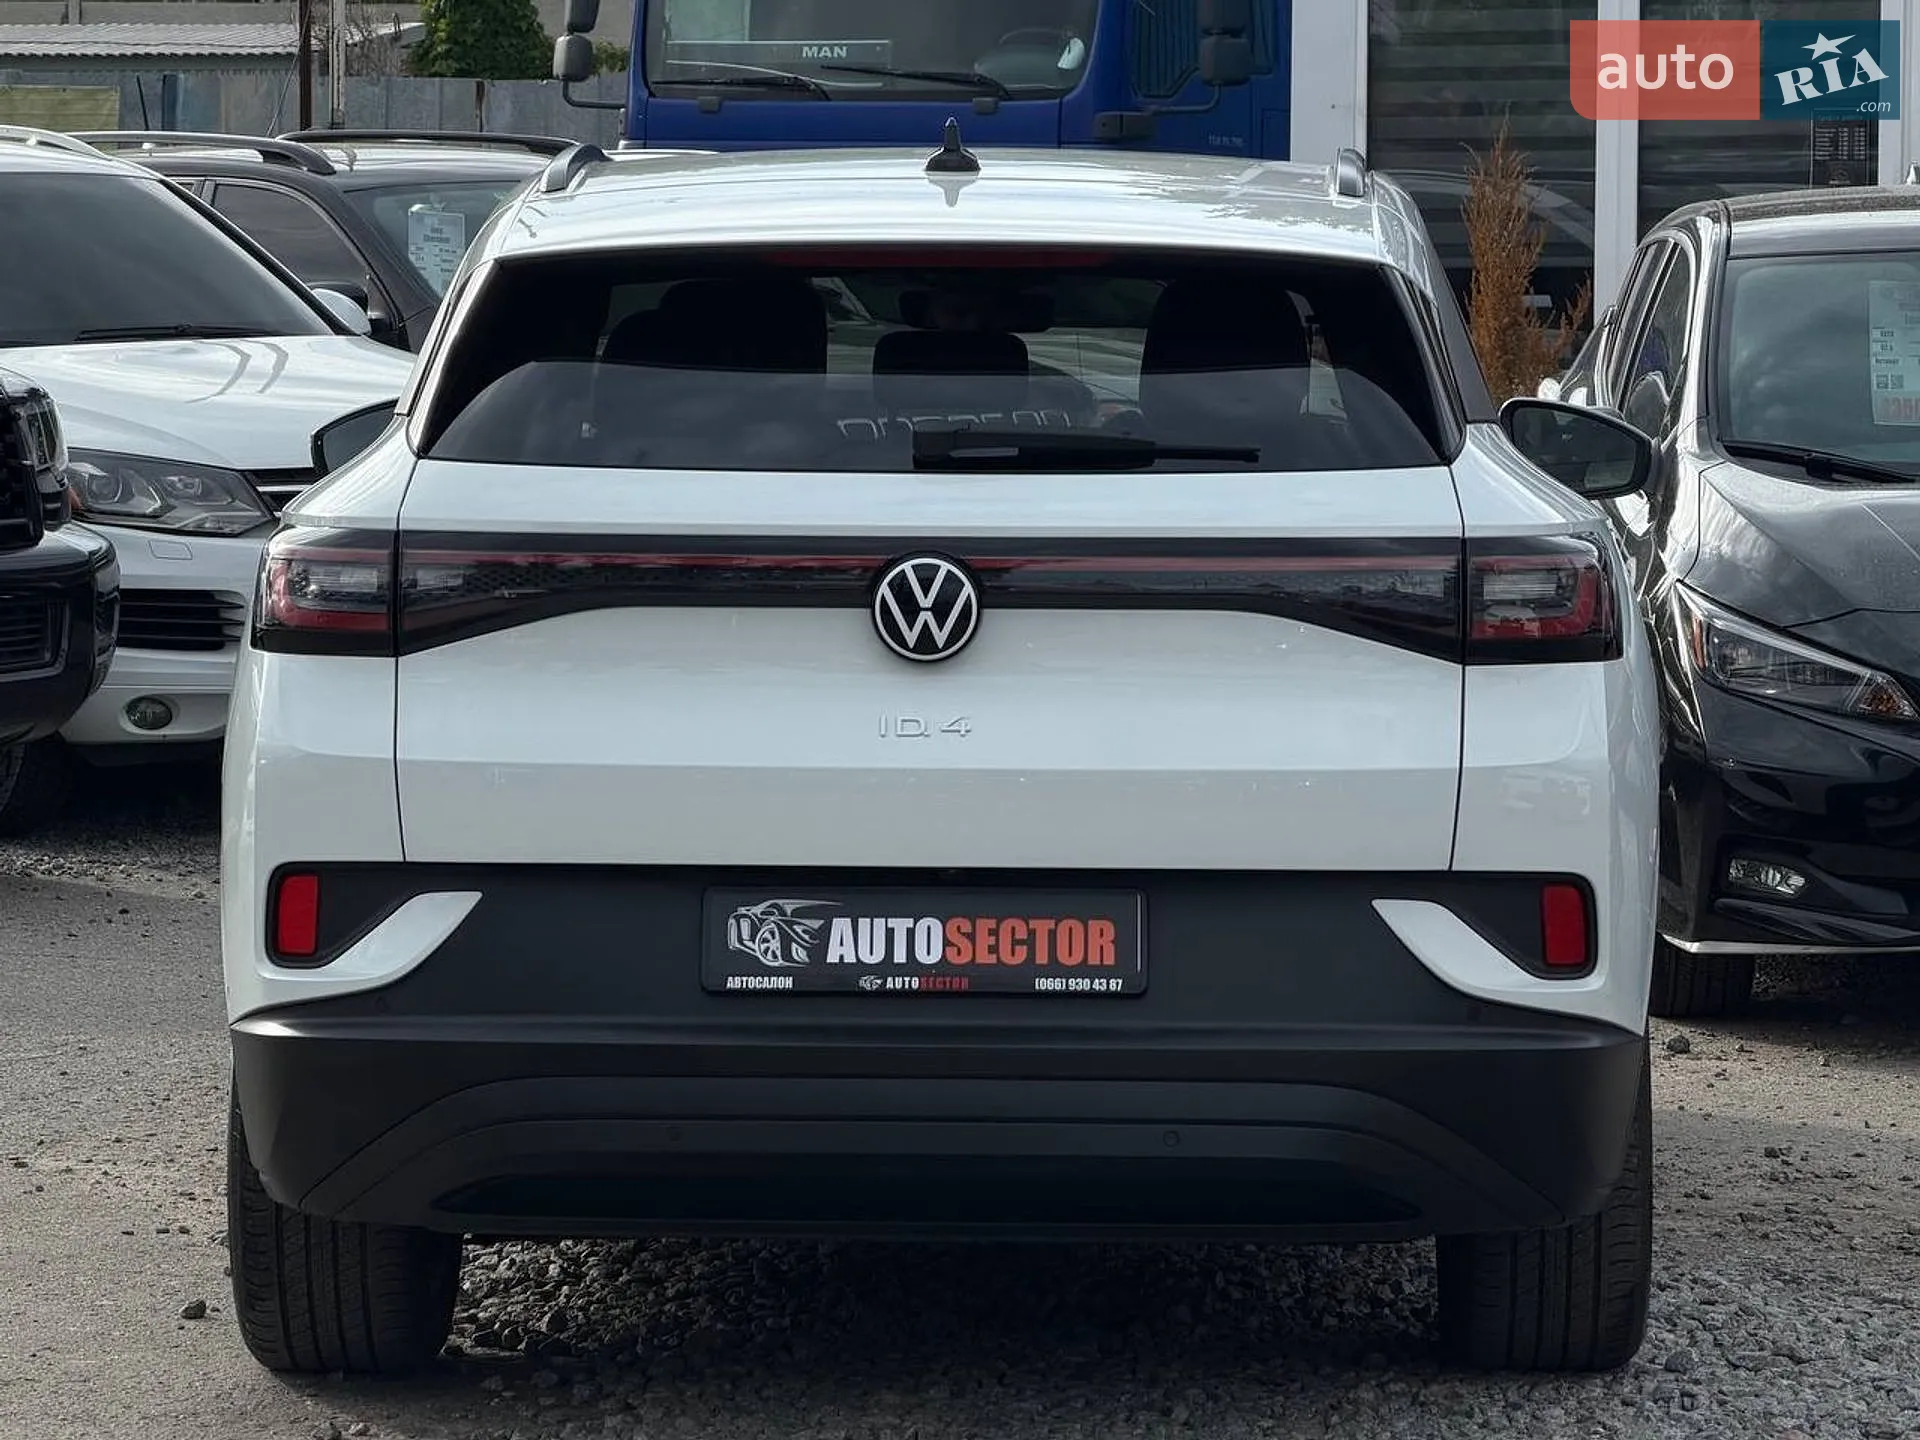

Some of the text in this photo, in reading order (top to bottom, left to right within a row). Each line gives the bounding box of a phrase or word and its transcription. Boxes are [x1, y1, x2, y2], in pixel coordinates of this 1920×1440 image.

[802, 46, 848, 59] MAN
[825, 916, 1116, 967] AUTOSECTOR
[726, 976, 793, 989] АВТОСАЛОН
[1068, 977, 1091, 991] 930
[1092, 978, 1107, 991] 43
